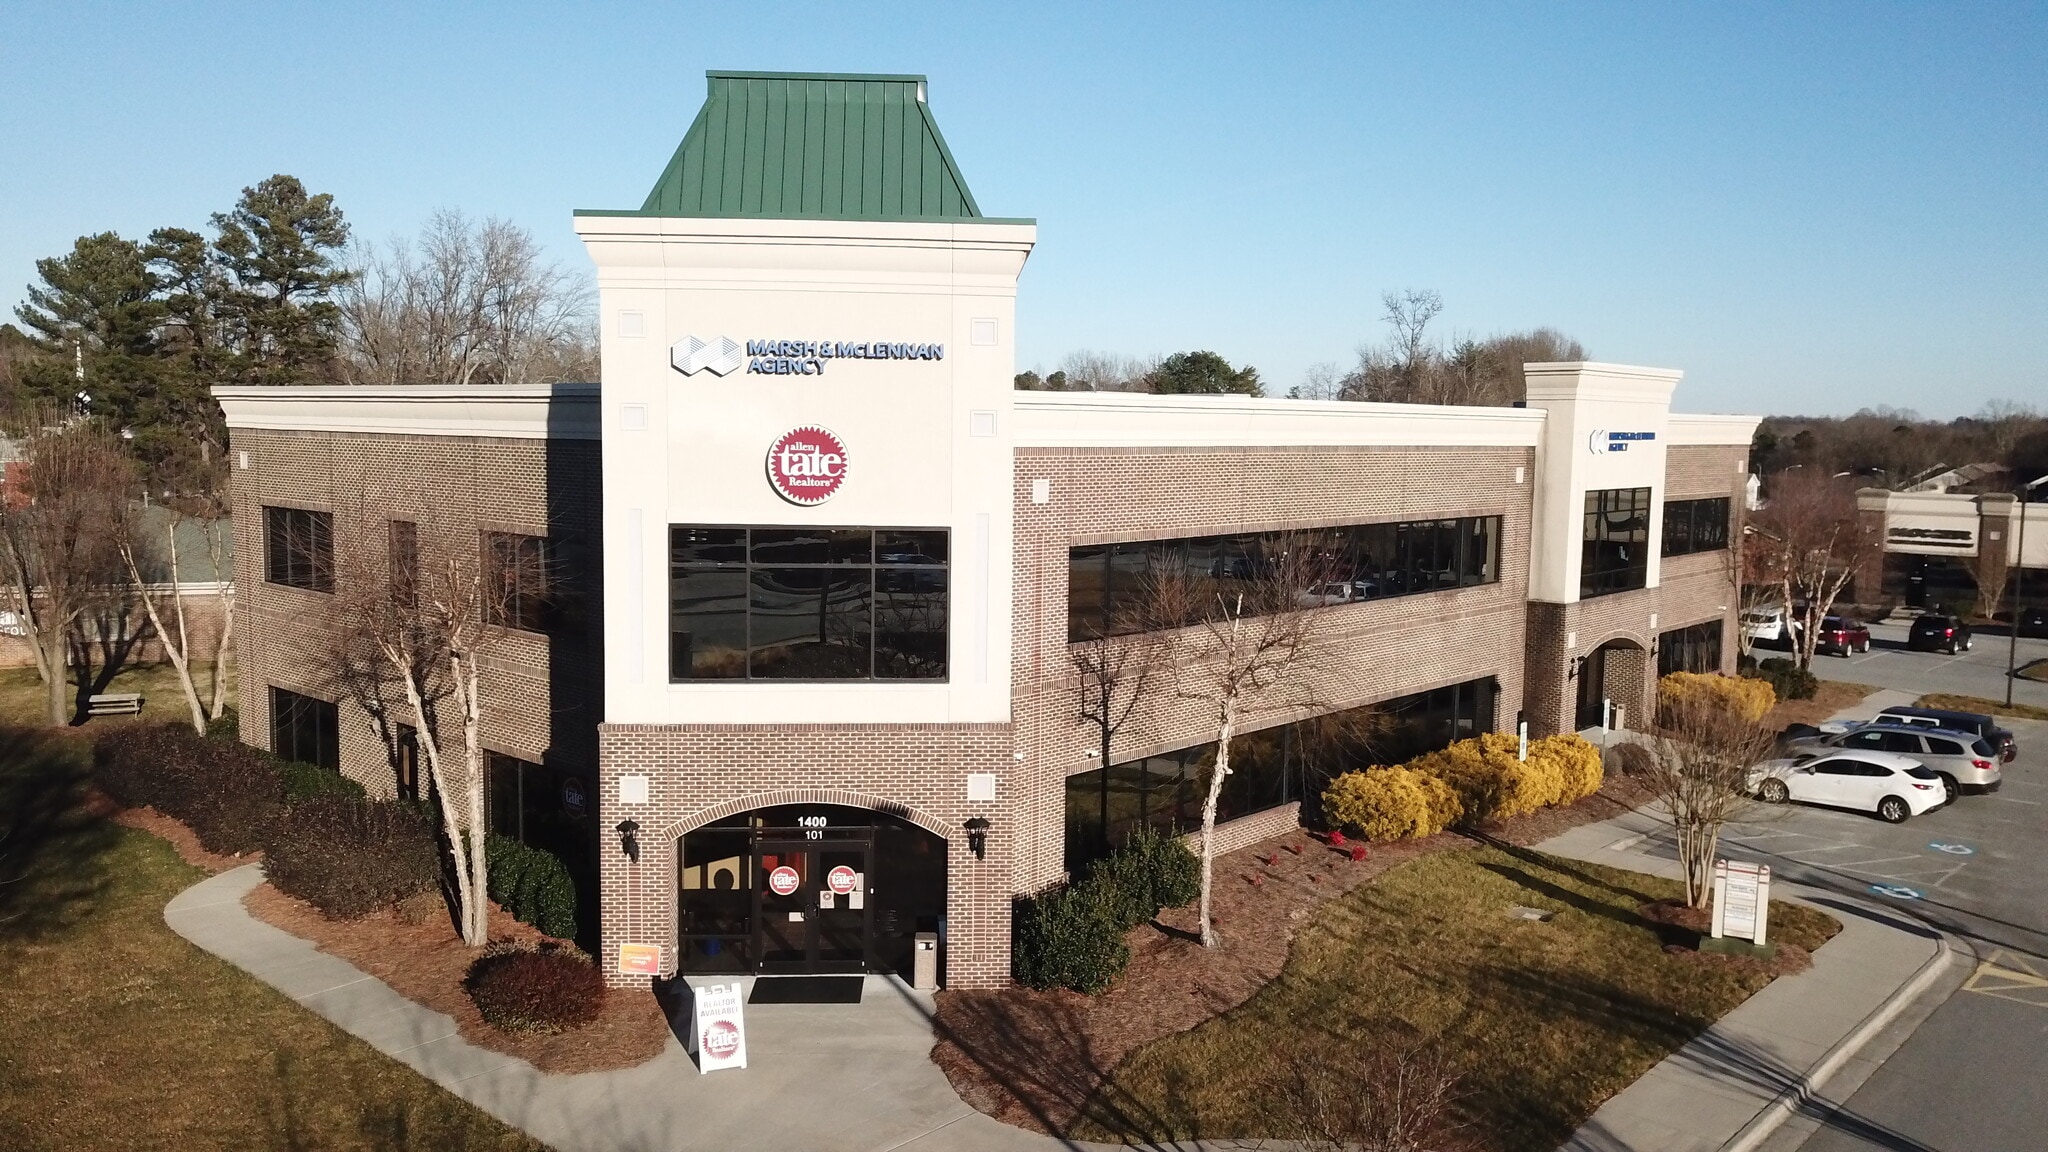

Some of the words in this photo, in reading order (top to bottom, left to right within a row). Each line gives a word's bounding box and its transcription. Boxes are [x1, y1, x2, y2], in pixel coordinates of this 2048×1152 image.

[747, 339, 817, 357] MARSH
[819, 341, 834, 358] &
[747, 357, 829, 375] AGENCY
[790, 441, 814, 451] allen
[777, 444, 842, 477] tate
[565, 787, 583, 807] tate
[797, 816, 827, 827] 1400
[805, 830, 823, 840] 101
[773, 873, 797, 886] tate
[831, 872, 855, 886] tate
[703, 998, 736, 1009] REALTOR
[700, 1006, 739, 1018] AVAILABLE
[706, 1028, 739, 1048] tate
